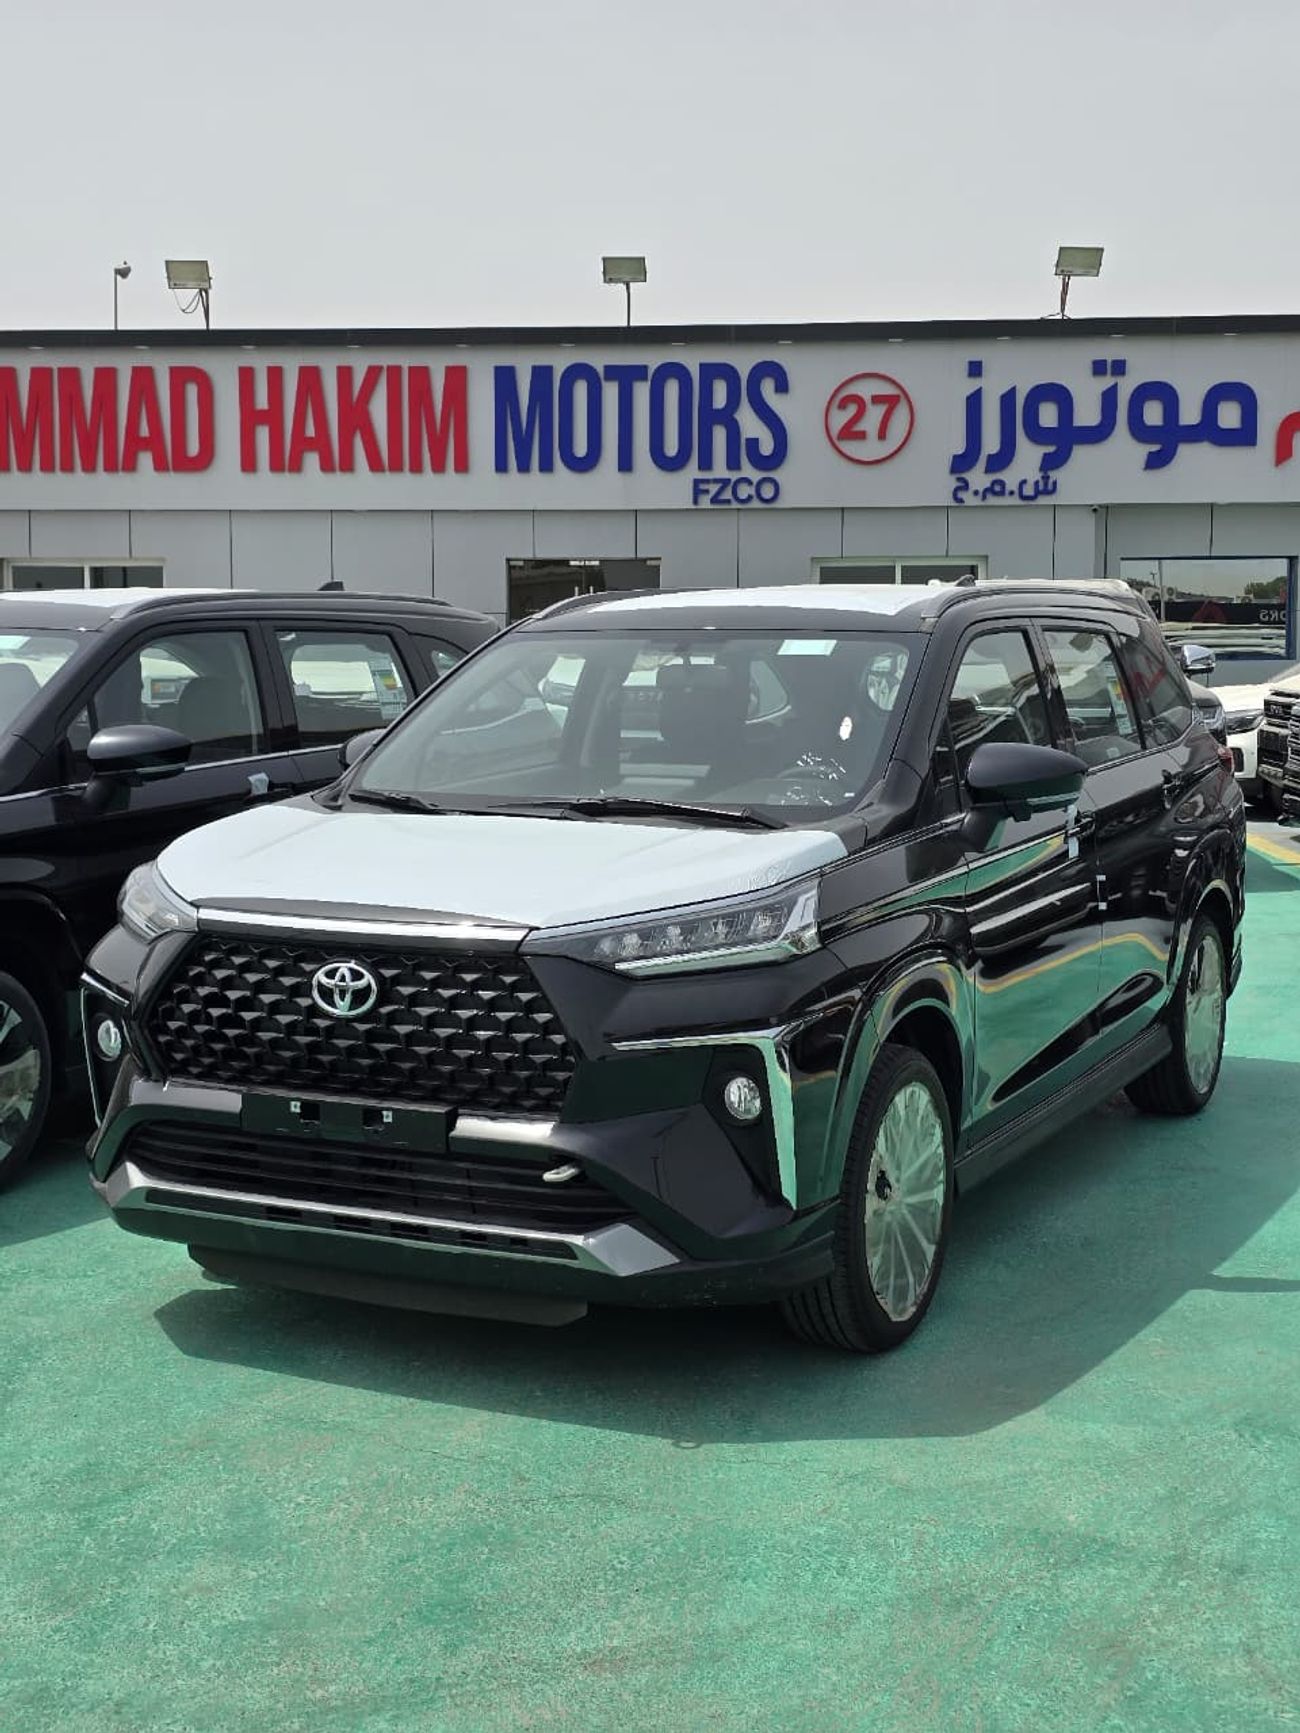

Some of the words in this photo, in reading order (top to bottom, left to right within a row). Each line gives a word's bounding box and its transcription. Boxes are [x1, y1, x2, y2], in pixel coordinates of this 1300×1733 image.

[238, 364, 469, 473] HAKIM
[493, 361, 789, 474] MOTORS
[837, 394, 901, 441] 27
[950, 358, 1258, 475] موتورز
[692, 476, 781, 505] FZCO
